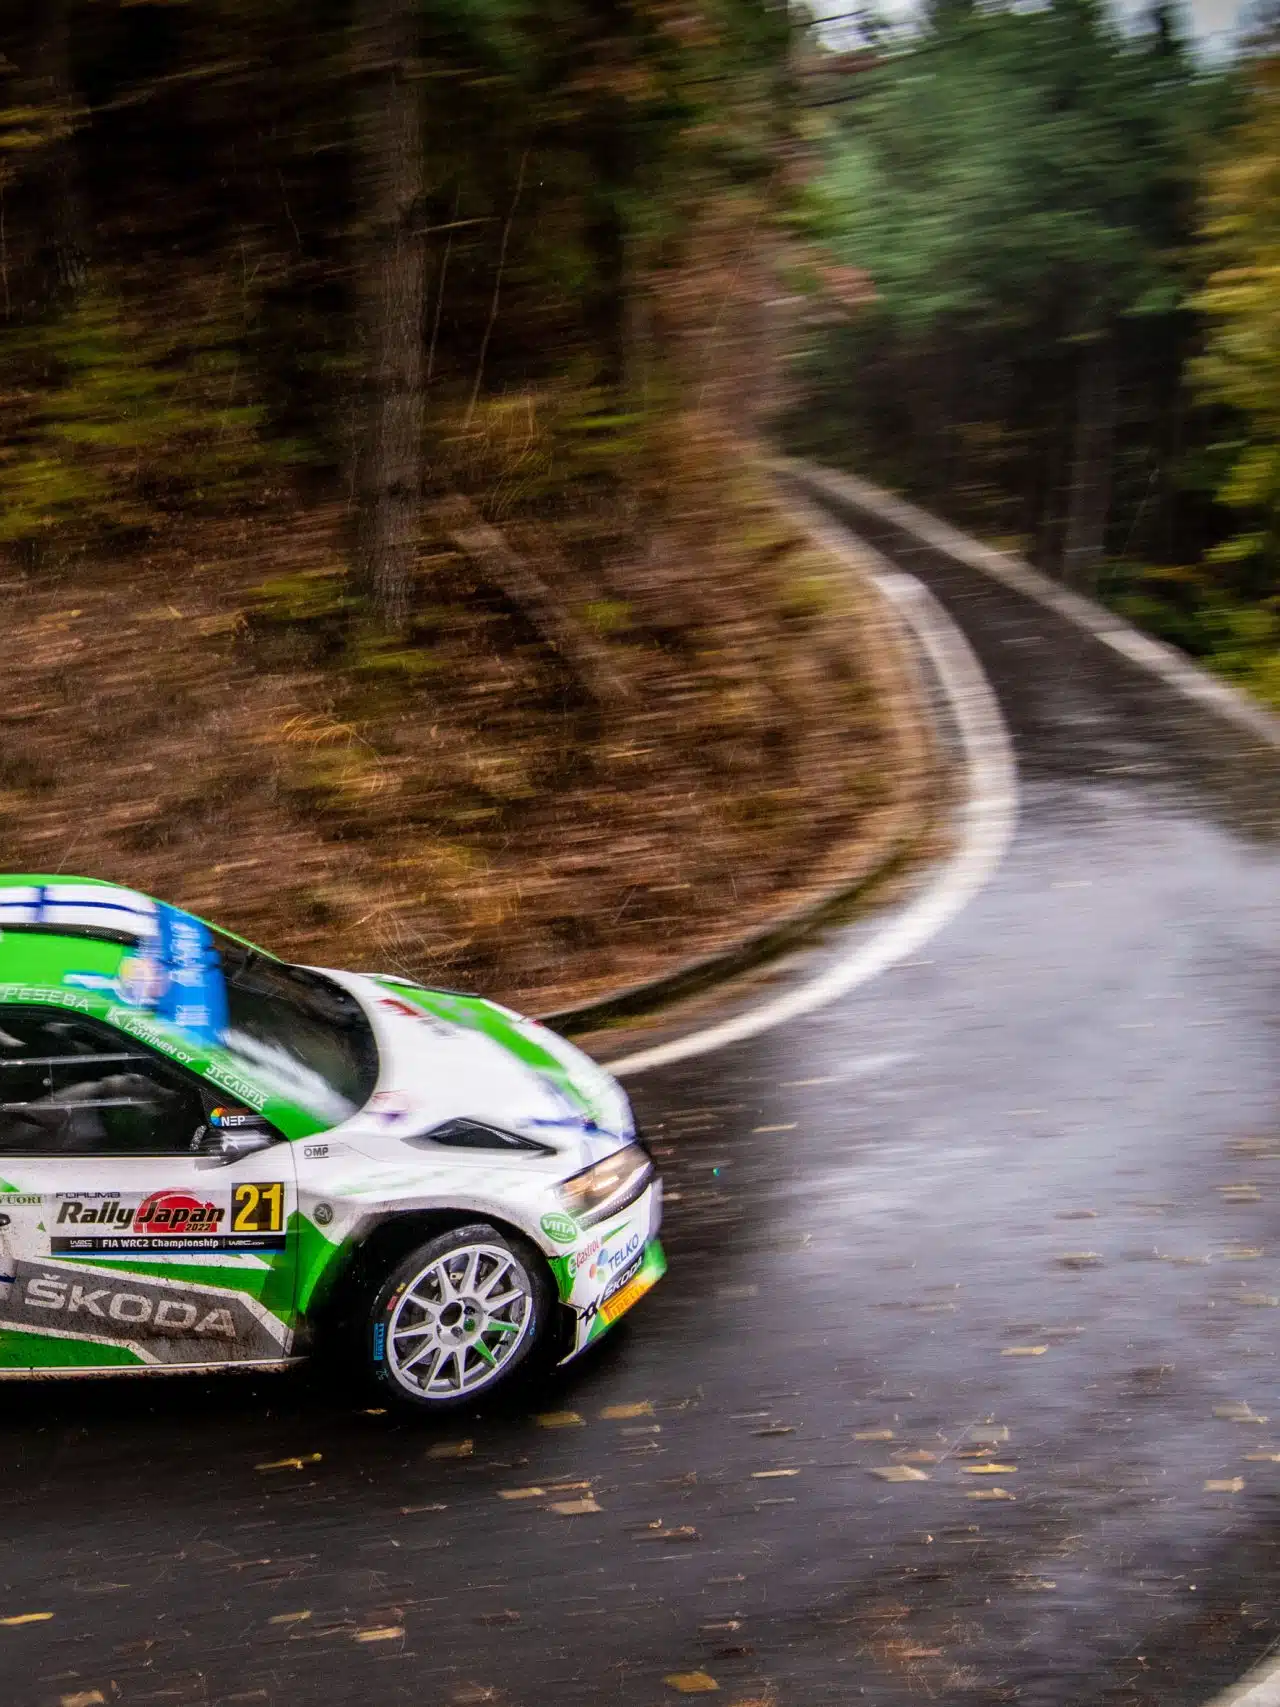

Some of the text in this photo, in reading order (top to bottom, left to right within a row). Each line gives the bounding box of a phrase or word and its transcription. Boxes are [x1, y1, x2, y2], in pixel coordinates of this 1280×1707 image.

[3, 986, 89, 1011] PESEBA
[124, 1022, 193, 1063] LAHTINEN OY
[303, 1147, 329, 1157] OMP
[55, 1201, 226, 1230] Rally Japan
[234, 1184, 282, 1231] 21
[184, 1222, 211, 1231] 2022
[102, 1238, 219, 1249] FIA WRC2 Championship
[607, 1232, 639, 1271] TELKO
[24, 1272, 237, 1338] ŠKODA
